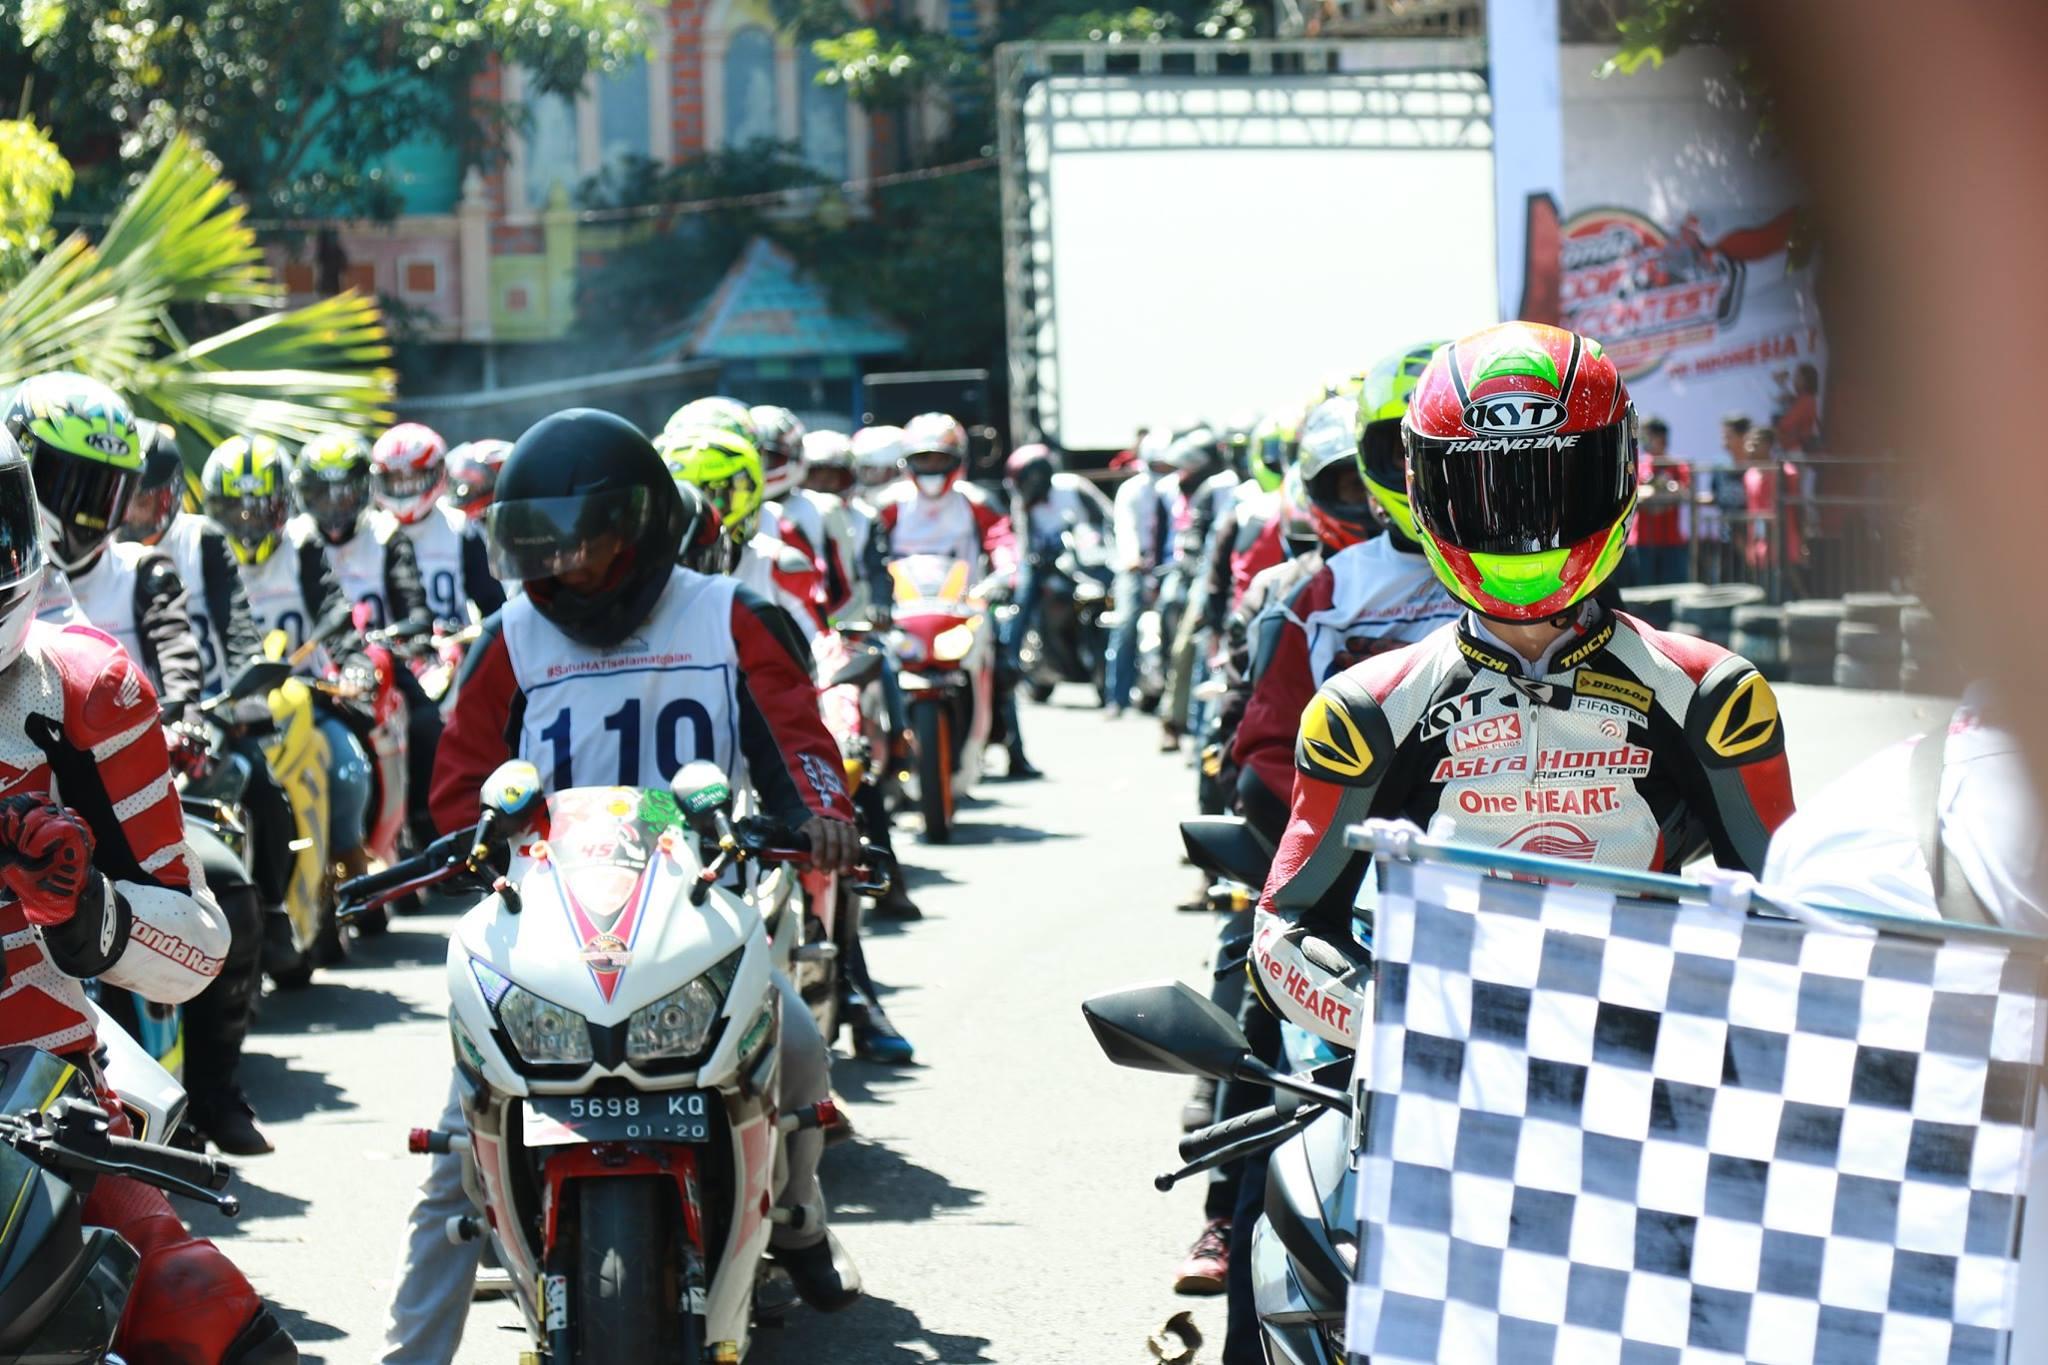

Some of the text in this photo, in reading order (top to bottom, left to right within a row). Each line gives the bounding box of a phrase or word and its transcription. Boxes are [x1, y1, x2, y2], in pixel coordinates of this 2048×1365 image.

[1474, 401, 1557, 430] KYT
[1456, 638, 1509, 674] TAICHI
[1560, 625, 1613, 669] TAICHI
[1592, 680, 1649, 703] DUNLOP
[1422, 687, 1496, 739] KYT
[1578, 698, 1646, 725] FIFASTRA
[1456, 715, 1520, 749] NGK
[1435, 746, 1650, 780] Astra Honda
[1535, 766, 1648, 780] Racing Team
[1459, 786, 1621, 815] One HEART.
[129, 915, 226, 977] ondaRa
[1282, 965, 1352, 1035] HEART.
[570, 1095, 704, 1117] 5698 KQ
